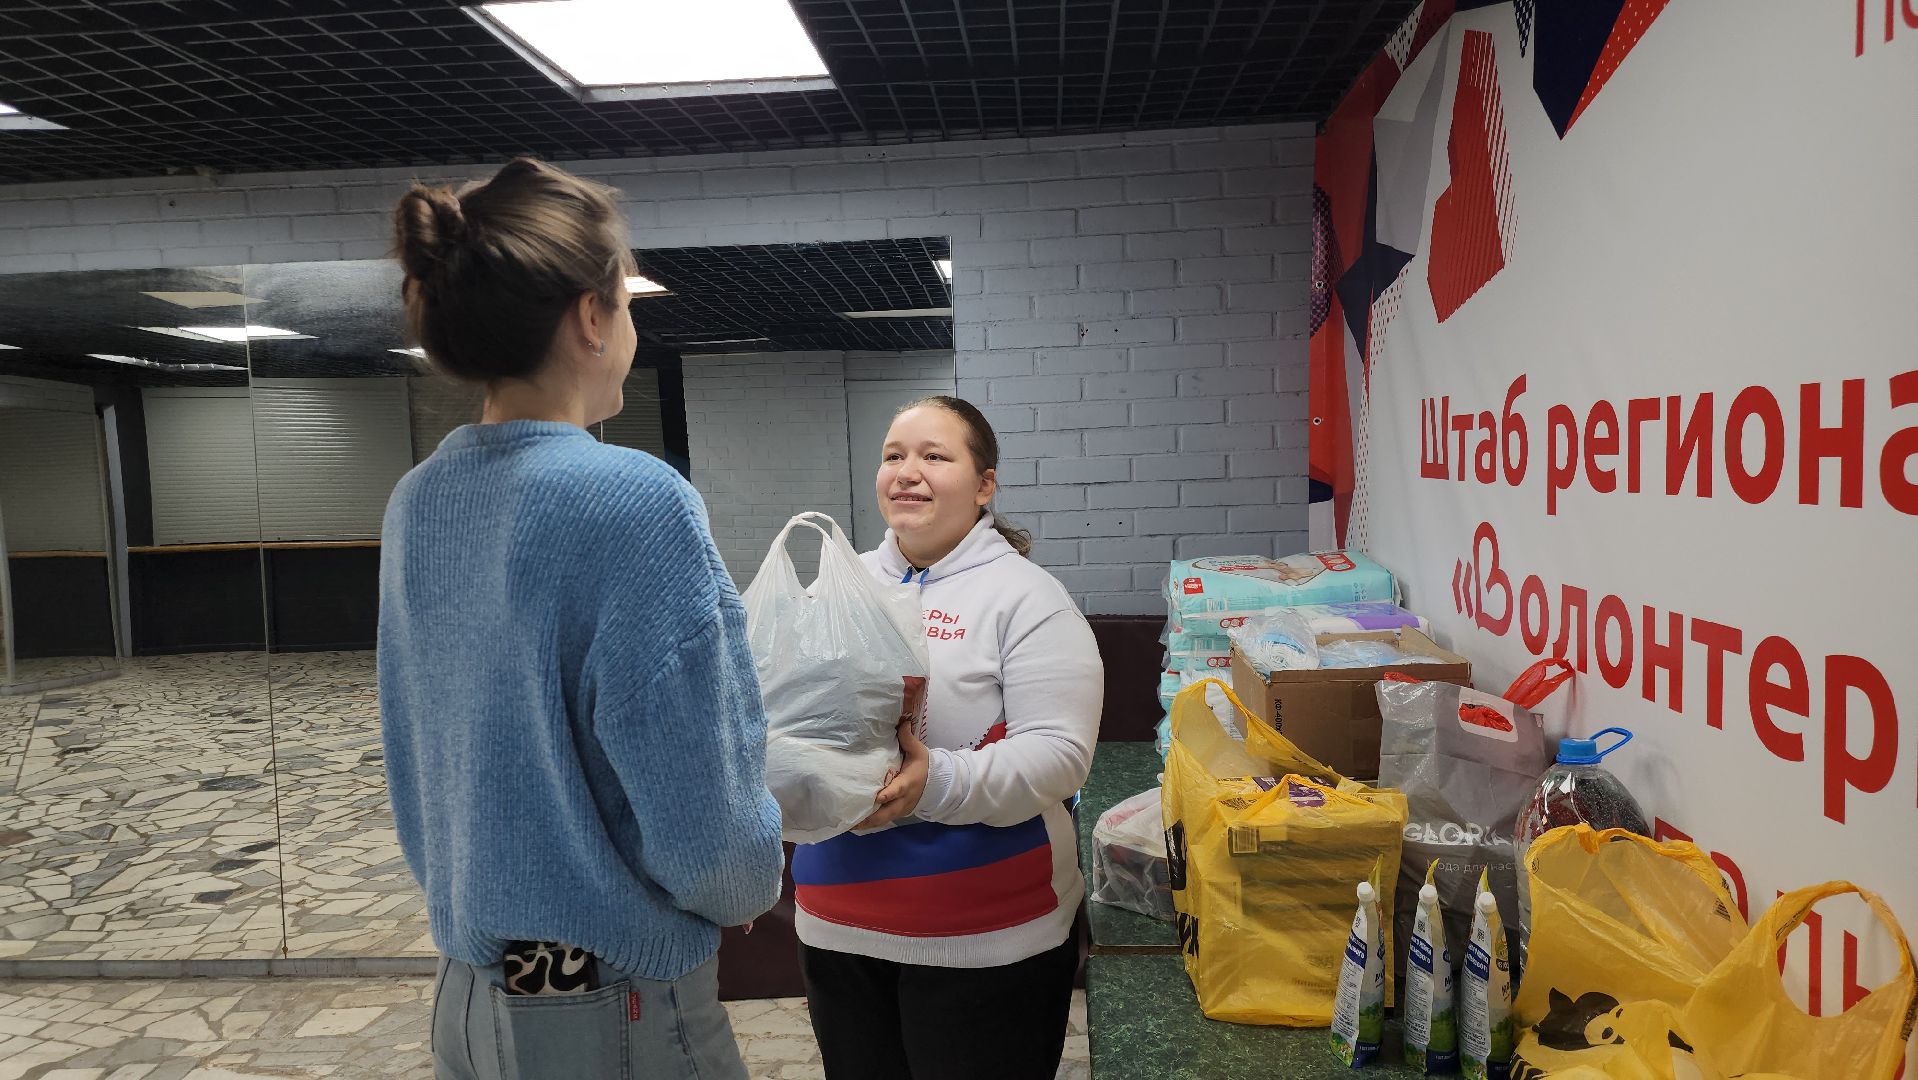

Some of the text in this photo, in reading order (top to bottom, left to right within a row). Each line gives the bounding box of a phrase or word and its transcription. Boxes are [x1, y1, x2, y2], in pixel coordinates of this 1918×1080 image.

[1420, 374, 1529, 487] Штаб
[925, 626, 966, 641] ВЬЯ
[1452, 521, 1918, 825] «Волонтер
[1402, 822, 1514, 846] GLORIA
[1490, 862, 1516, 872] нас
